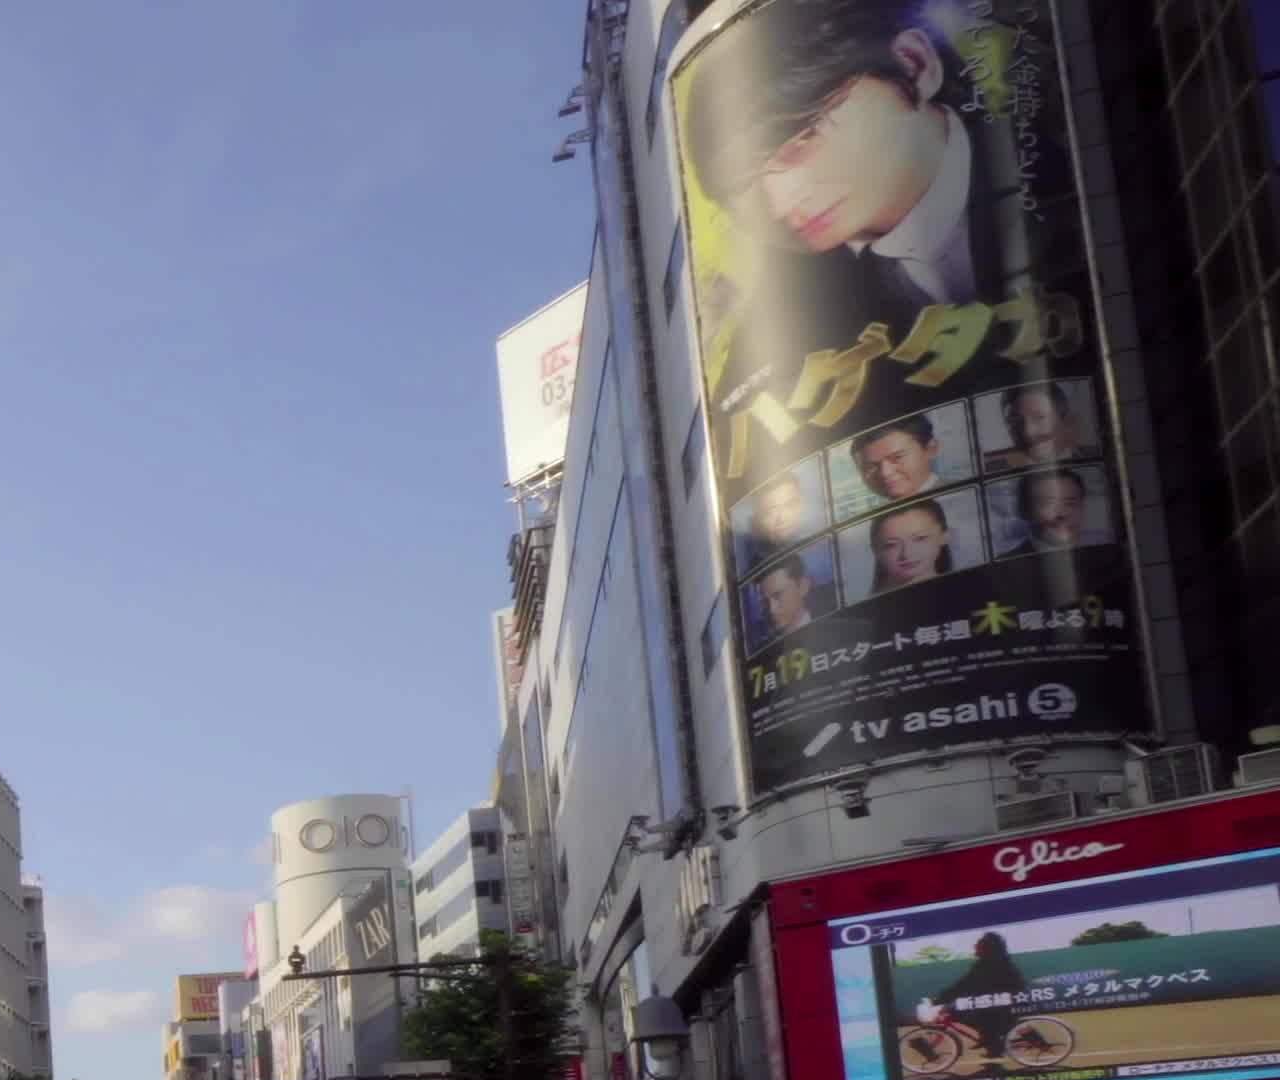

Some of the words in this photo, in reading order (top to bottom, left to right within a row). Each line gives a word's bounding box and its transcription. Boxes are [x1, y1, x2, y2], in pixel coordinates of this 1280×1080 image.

[850, 715, 890, 743] tv
[903, 692, 1017, 734] asahi
[993, 839, 1125, 882] Glico
[1063, 967, 1212, 999] メタルマクベス
